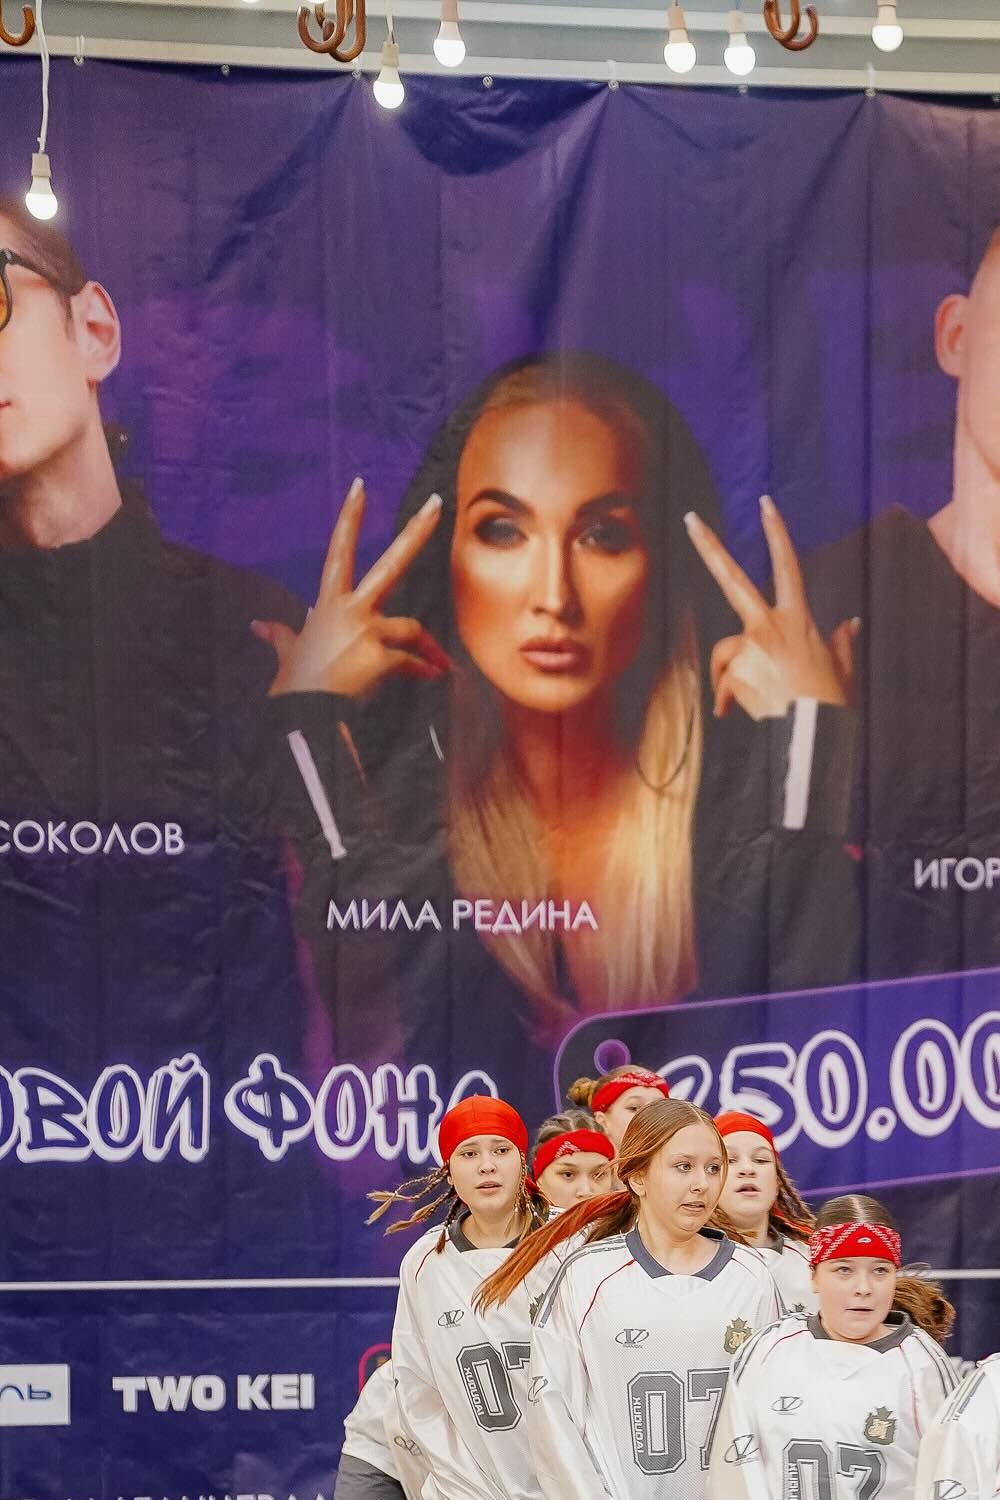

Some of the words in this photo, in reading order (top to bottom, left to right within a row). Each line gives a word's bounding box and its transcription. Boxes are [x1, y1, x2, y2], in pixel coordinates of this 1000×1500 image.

[326, 898, 443, 931] МИЛА
[452, 898, 600, 935] РЕДИНА
[0, 1053, 210, 1164] ВОЙ
[224, 1053, 499, 1166] ФОН
[112, 1374, 227, 1412] TWO
[236, 1372, 316, 1410] KEI
